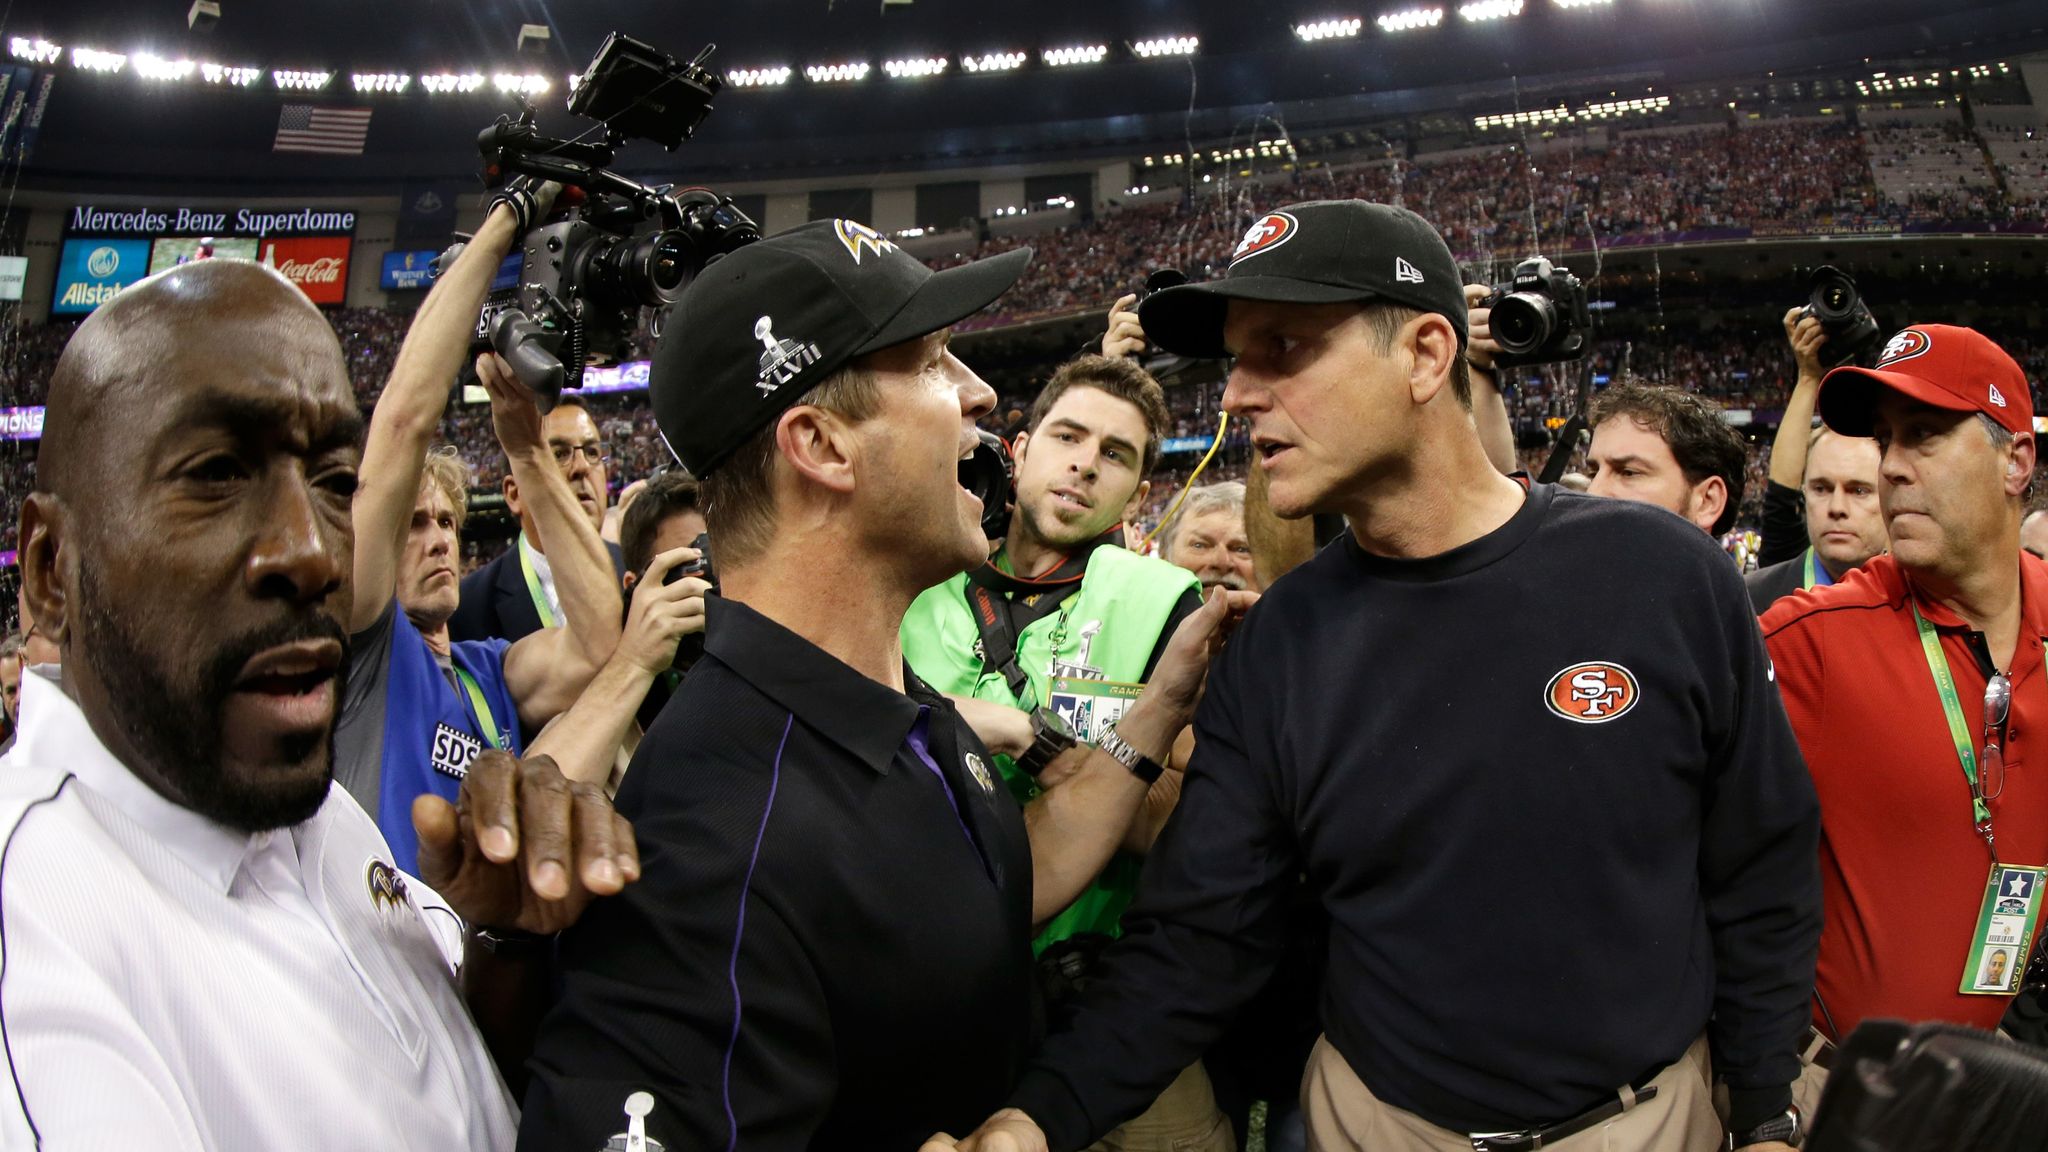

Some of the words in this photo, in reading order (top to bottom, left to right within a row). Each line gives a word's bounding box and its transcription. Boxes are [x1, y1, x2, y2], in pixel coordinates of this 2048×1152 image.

[71, 206, 226, 232] Mercedes-Benz
[235, 208, 354, 236] Superdome
[1752, 227, 1802, 236] NATIONAL
[1806, 225, 1860, 234] FOOTBALL
[1862, 223, 1902, 233] LEAGUE
[279, 257, 344, 284] Coca-Cola
[1516, 275, 1538, 284] Nikon
[61, 282, 122, 305] Allstat
[755, 343, 822, 398] XLVII
[1571, 671, 1623, 715] SF
[2012, 967, 2021, 990] DAY
